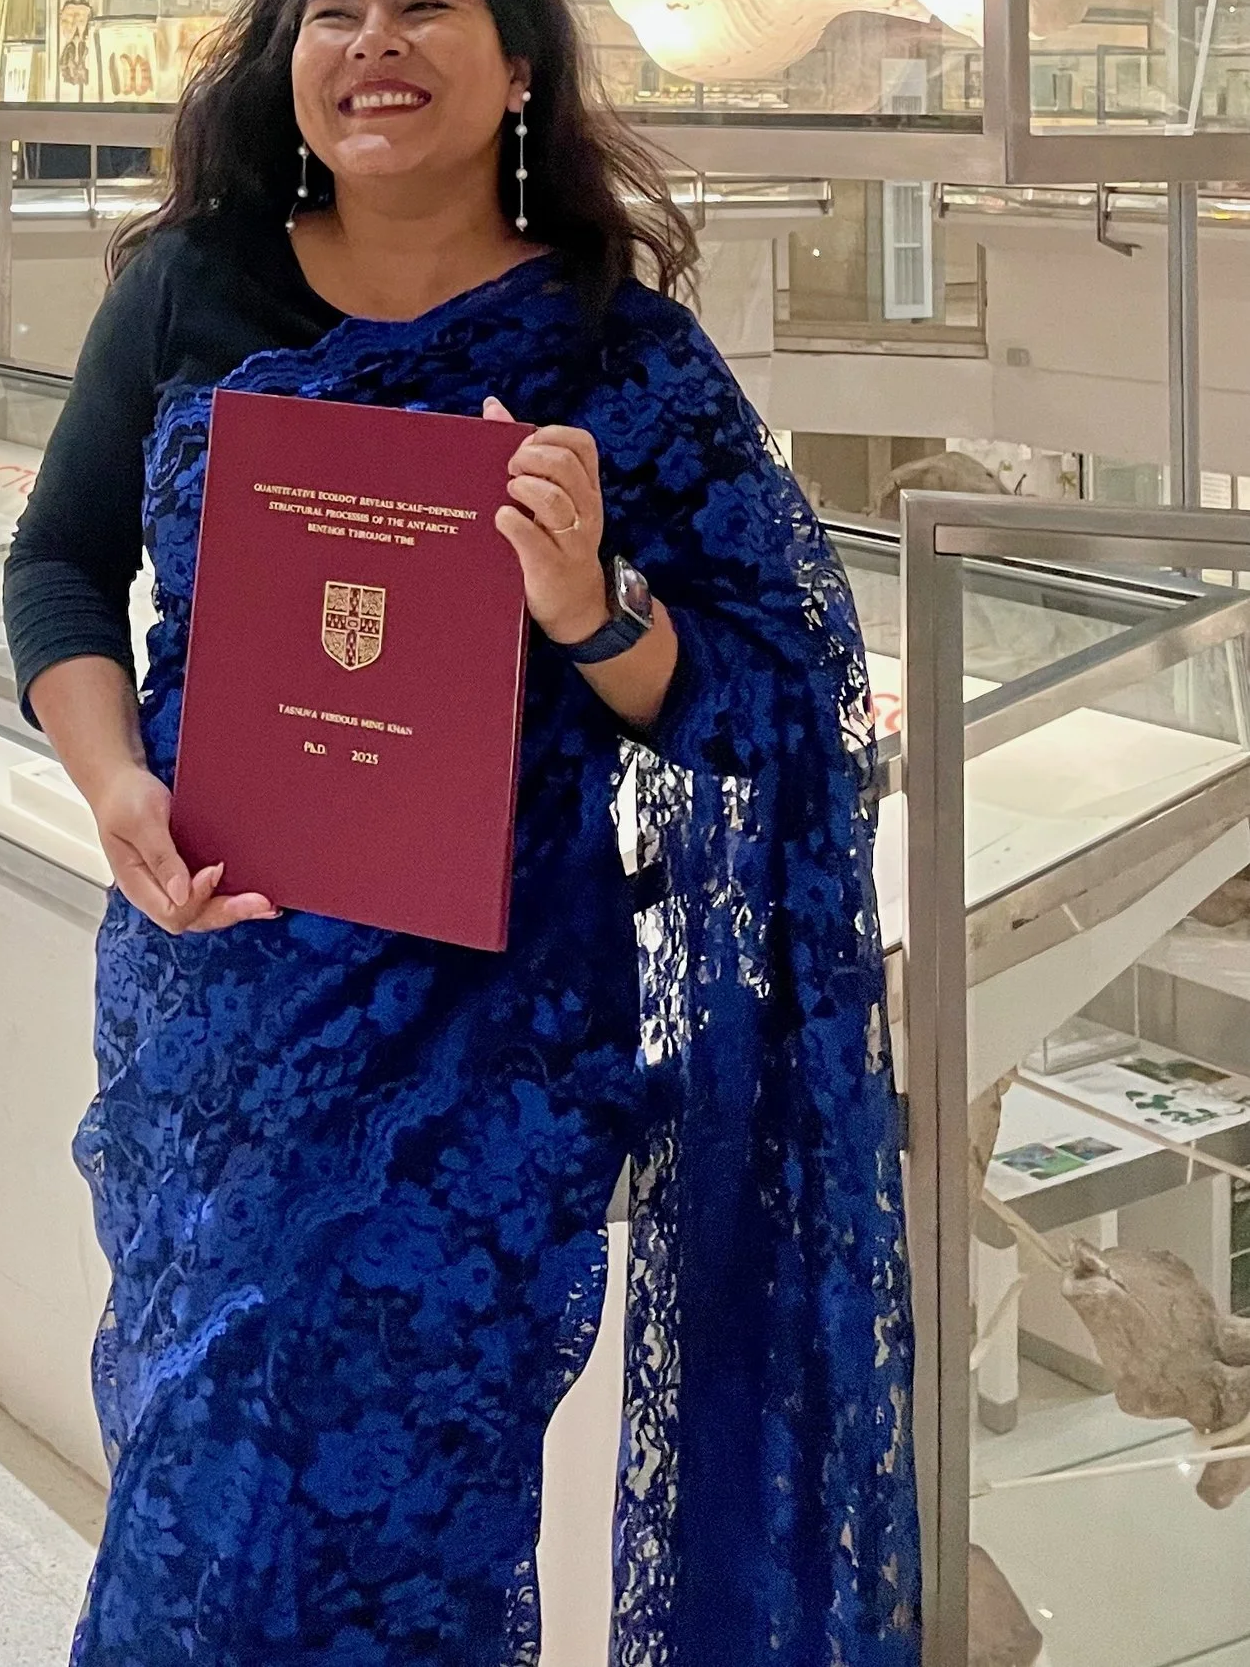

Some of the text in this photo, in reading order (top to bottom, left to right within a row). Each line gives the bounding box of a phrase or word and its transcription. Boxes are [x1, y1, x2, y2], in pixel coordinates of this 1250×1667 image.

[253, 483, 478, 521] QUANTITATIVE ECOLOGY REVEALS SCALE-DEPENDENT
[268, 501, 459, 535] STRUCTURAL PROCESSES OF THE ANTARCTIC
[348, 528, 392, 543] THROUGH
[394, 534, 415, 546] TIME
[360, 718, 385, 731] MING
[387, 723, 413, 736] KHAN
[351, 750, 379, 765] 2025
